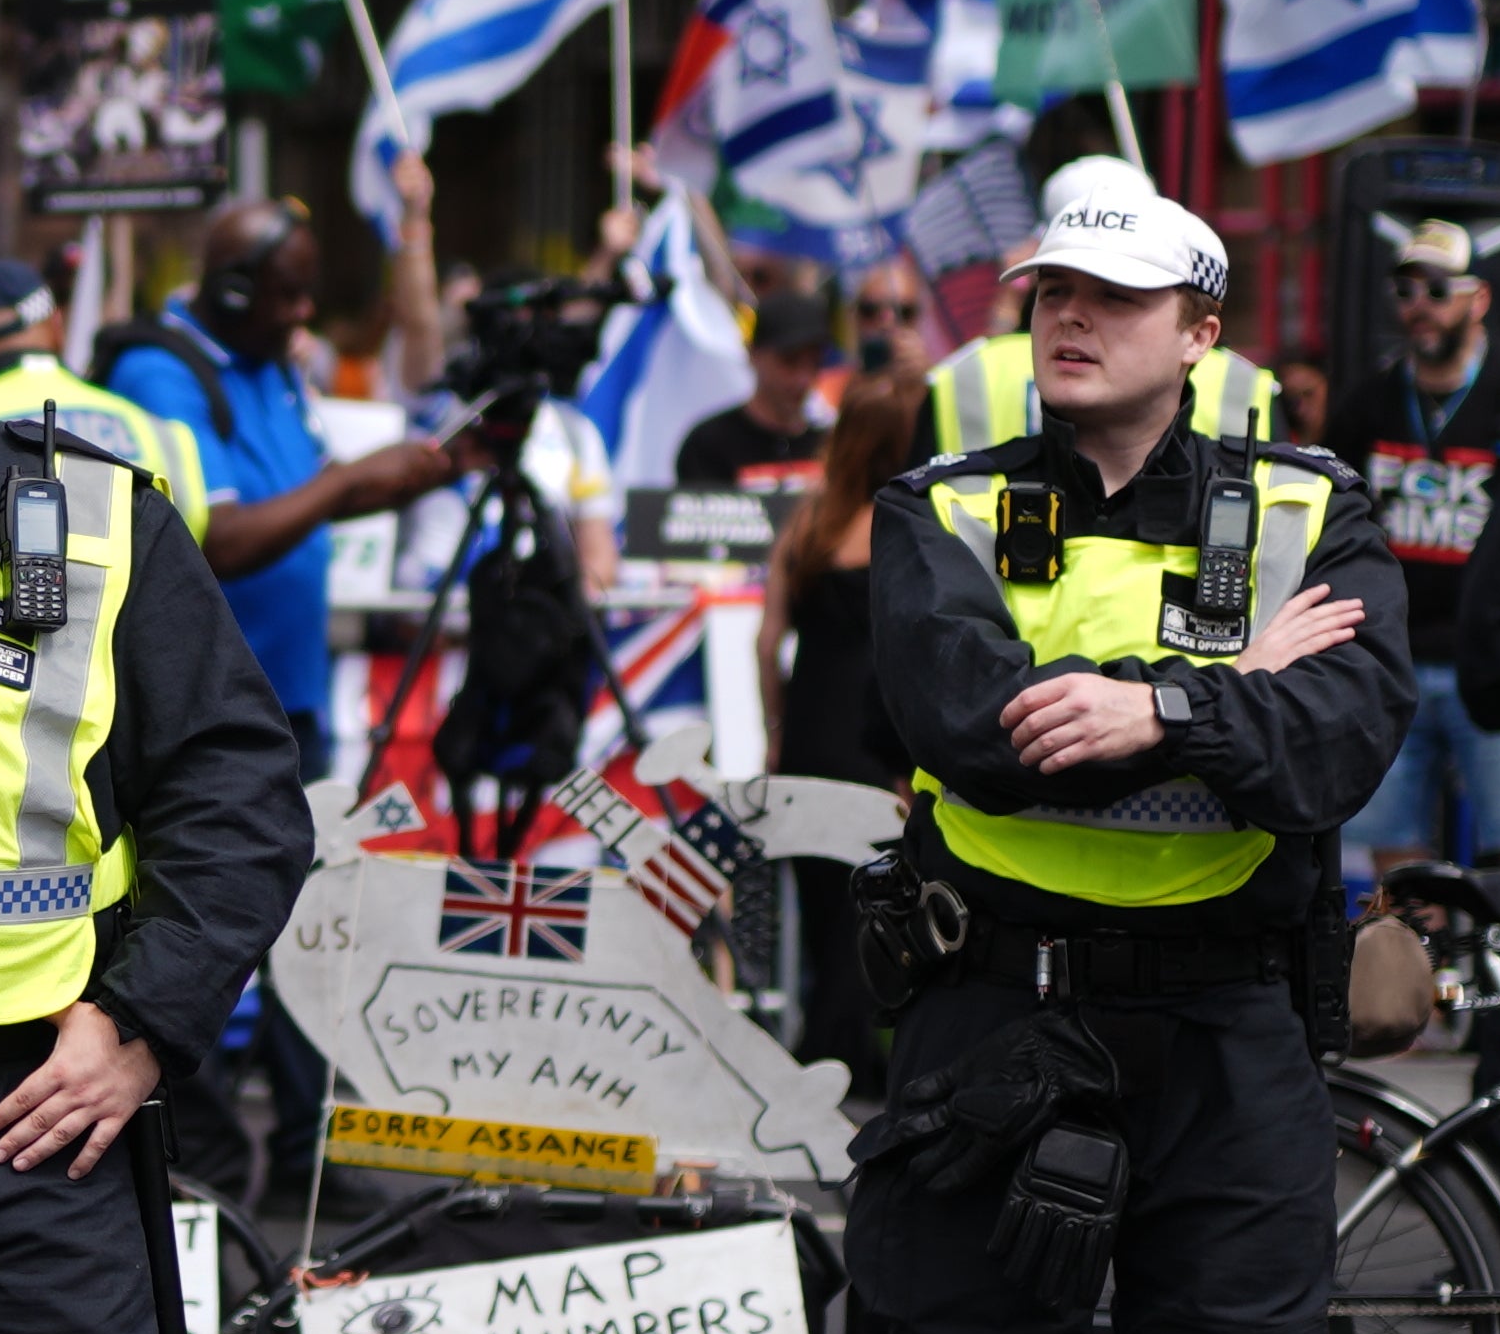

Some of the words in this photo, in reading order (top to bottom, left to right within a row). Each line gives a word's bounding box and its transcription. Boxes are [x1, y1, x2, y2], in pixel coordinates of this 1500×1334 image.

[1057, 208, 1138, 233] POLICE
[1369, 452, 1494, 505] FCK
[1162, 630, 1195, 649] POLICE
[1198, 640, 1243, 652] OFFICER
[1195, 625, 1231, 636] POLICE
[552, 768, 642, 858] HEEL
[296, 917, 361, 952] U.S.
[450, 1052, 511, 1079] MY
[338, 1110, 454, 1139] SORRY
[467, 1125, 641, 1164] ASSANGE
[488, 1251, 664, 1324] MAP
